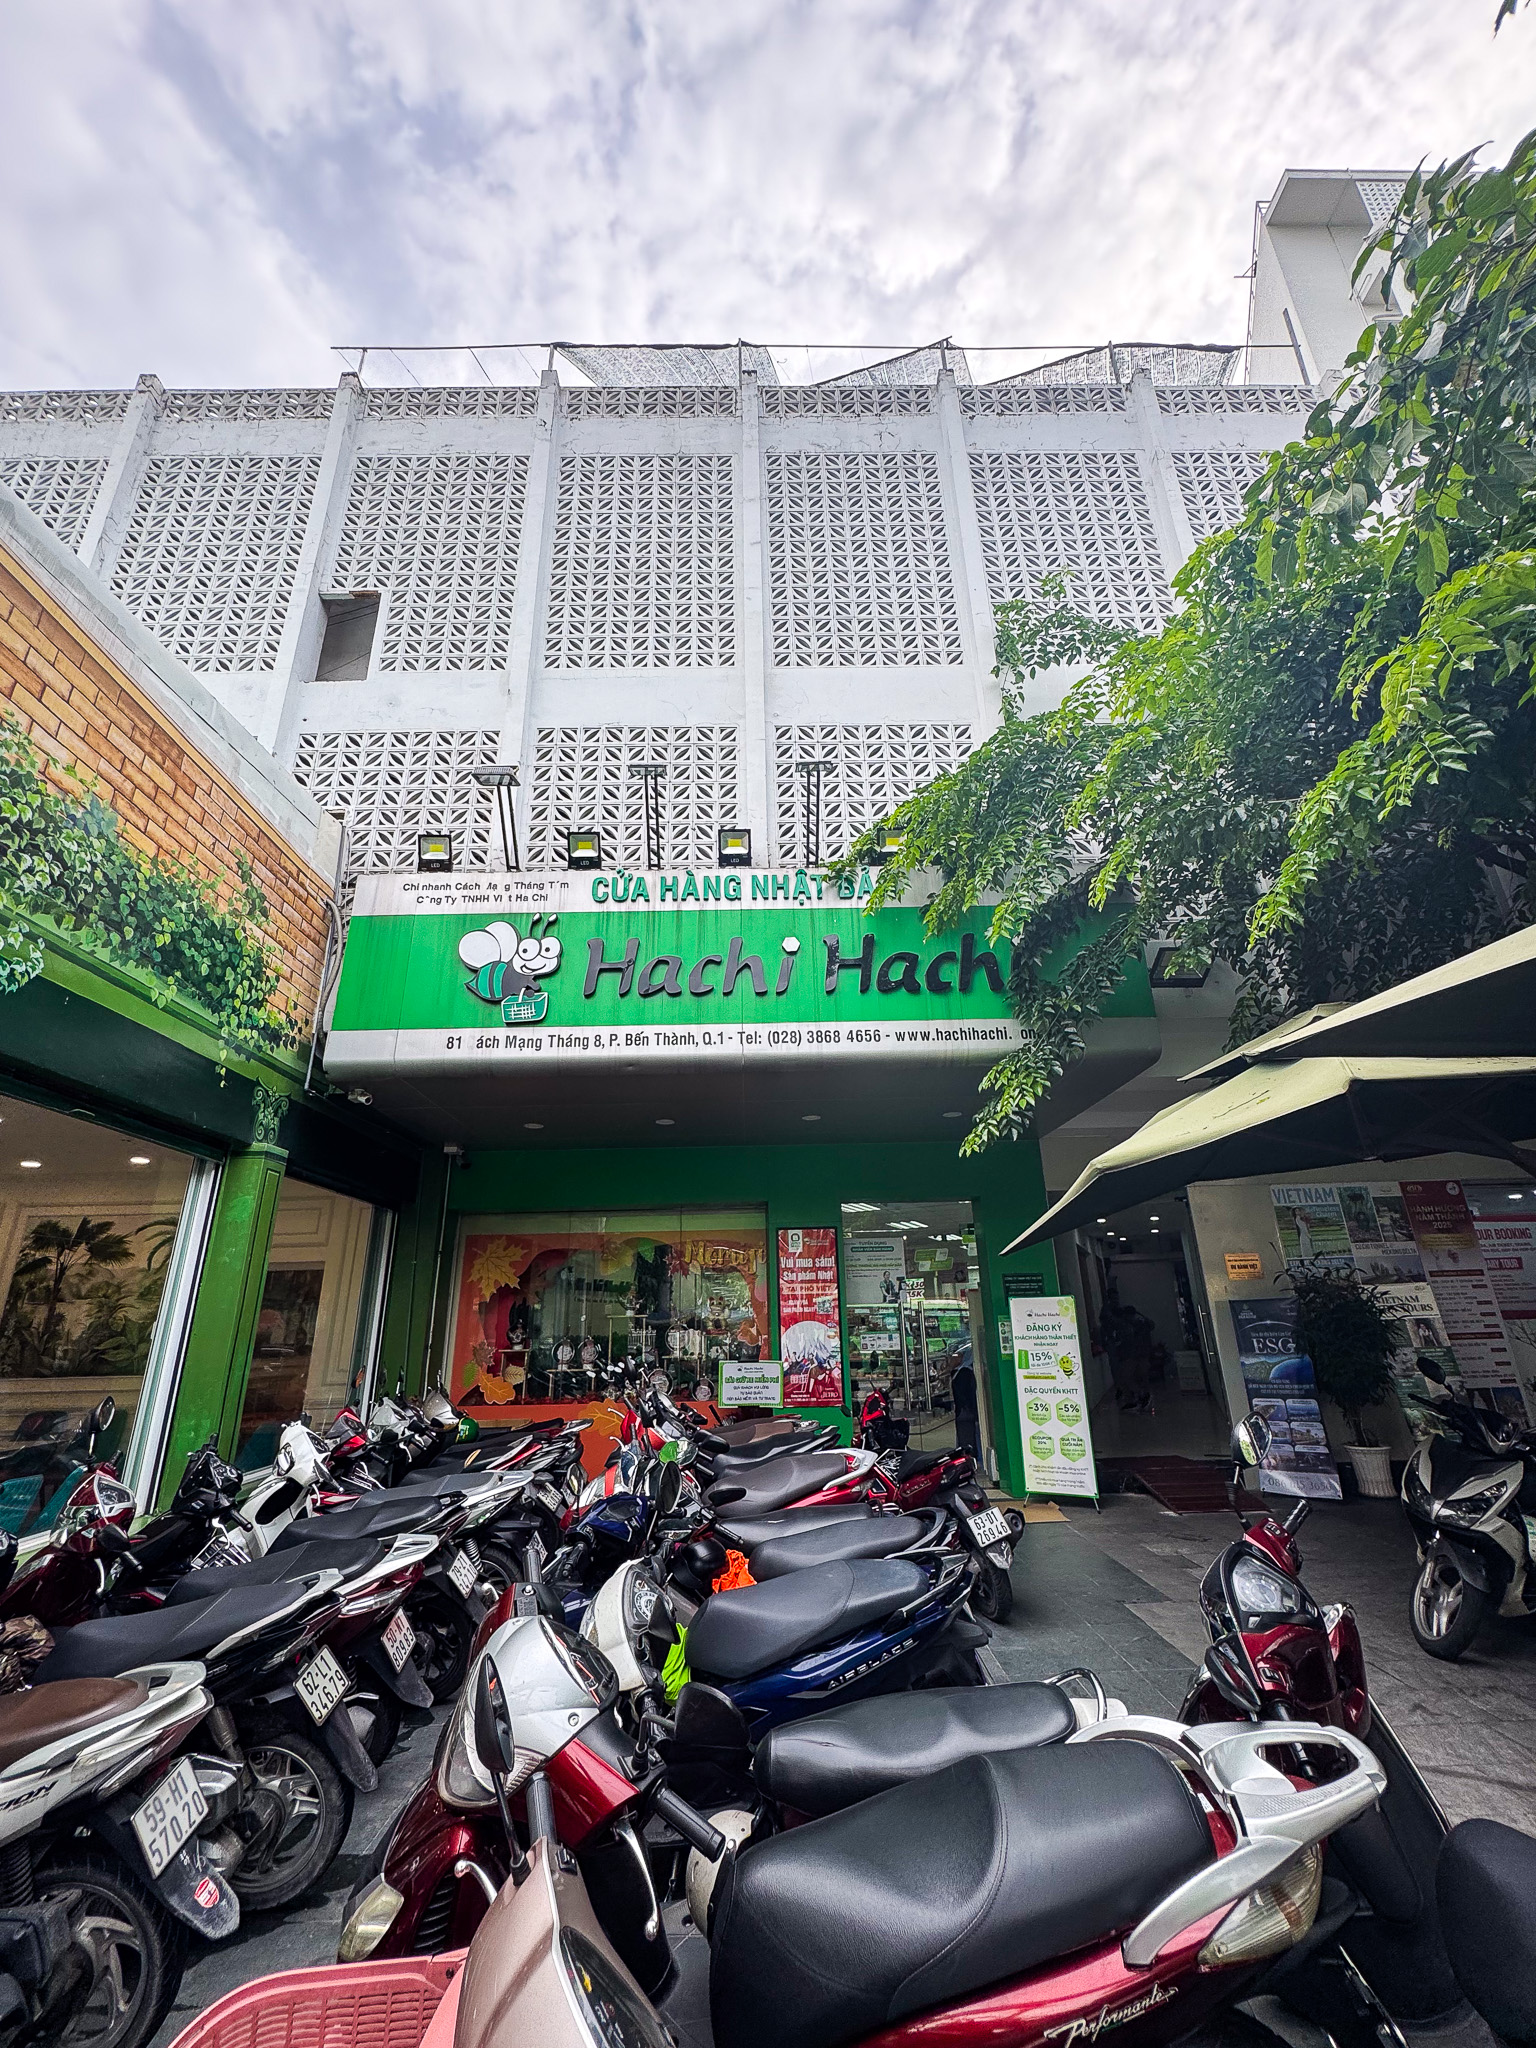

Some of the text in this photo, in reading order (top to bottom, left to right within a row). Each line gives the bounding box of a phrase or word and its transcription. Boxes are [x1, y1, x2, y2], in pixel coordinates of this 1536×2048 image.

[403, 883, 420, 891] Chi
[422, 883, 451, 891] nhanh
[455, 882, 481, 891] Cách
[514, 882, 545, 892] Tháng
[592, 866, 876, 905] CỬA HÀNG NHẬT BẢ
[445, 896, 457, 905] Ty
[462, 895, 490, 904] TNHH
[494, 895, 512, 903] Vit
[515, 894, 529, 902] Ha
[532, 893, 548, 902] Chi
[583, 936, 800, 997] Hachi
[446, 1036, 462, 1050] 81
[476, 1034, 500, 1049] ách
[505, 1035, 542, 1051] Mạng
[548, 1034, 589, 1050] Tháng
[594, 1035, 605, 1049] 8,
[609, 1034, 621, 1047] P.
[625, 1031, 650, 1047] Bến
[654, 1032, 699, 1047] Thành,
[702, 1032, 724, 1047] Q.1
[737, 1031, 762, 1045] Tel:
[767, 1030, 802, 1047] (028)
[806, 1030, 841, 1044] 3868
[846, 1029, 881, 1043] 4656
[1272, 1187, 1336, 1204] VIETNAM
[1433, 1221, 1453, 1229] 2025
[1494, 1227, 1533, 1240] BOOKING
[781, 1256, 794, 1268] Vui
[796, 1257, 813, 1268] mua
[1500, 1258, 1519, 1268] TOUR
[1026, 1321, 1062, 1332] ĐĂNG KÝ
[1252, 1338, 1296, 1354] ESG
[1030, 1351, 1053, 1361] 15%
[1024, 1386, 1038, 1395] ĐẶC
[1039, 1386, 1061, 1395] QUYỀN
[1029, 1402, 1049, 1412] -3%
[1059, 1403, 1080, 1413] -5%
[978, 1522, 1008, 1547] 269.46
[392, 1627, 414, 1667] 809.83
[302, 1655, 333, 1695] 62-L1
[311, 1670, 346, 1720] 346.79
[143, 1770, 189, 1833] 59-H1
[149, 1790, 205, 1868] 570.20
